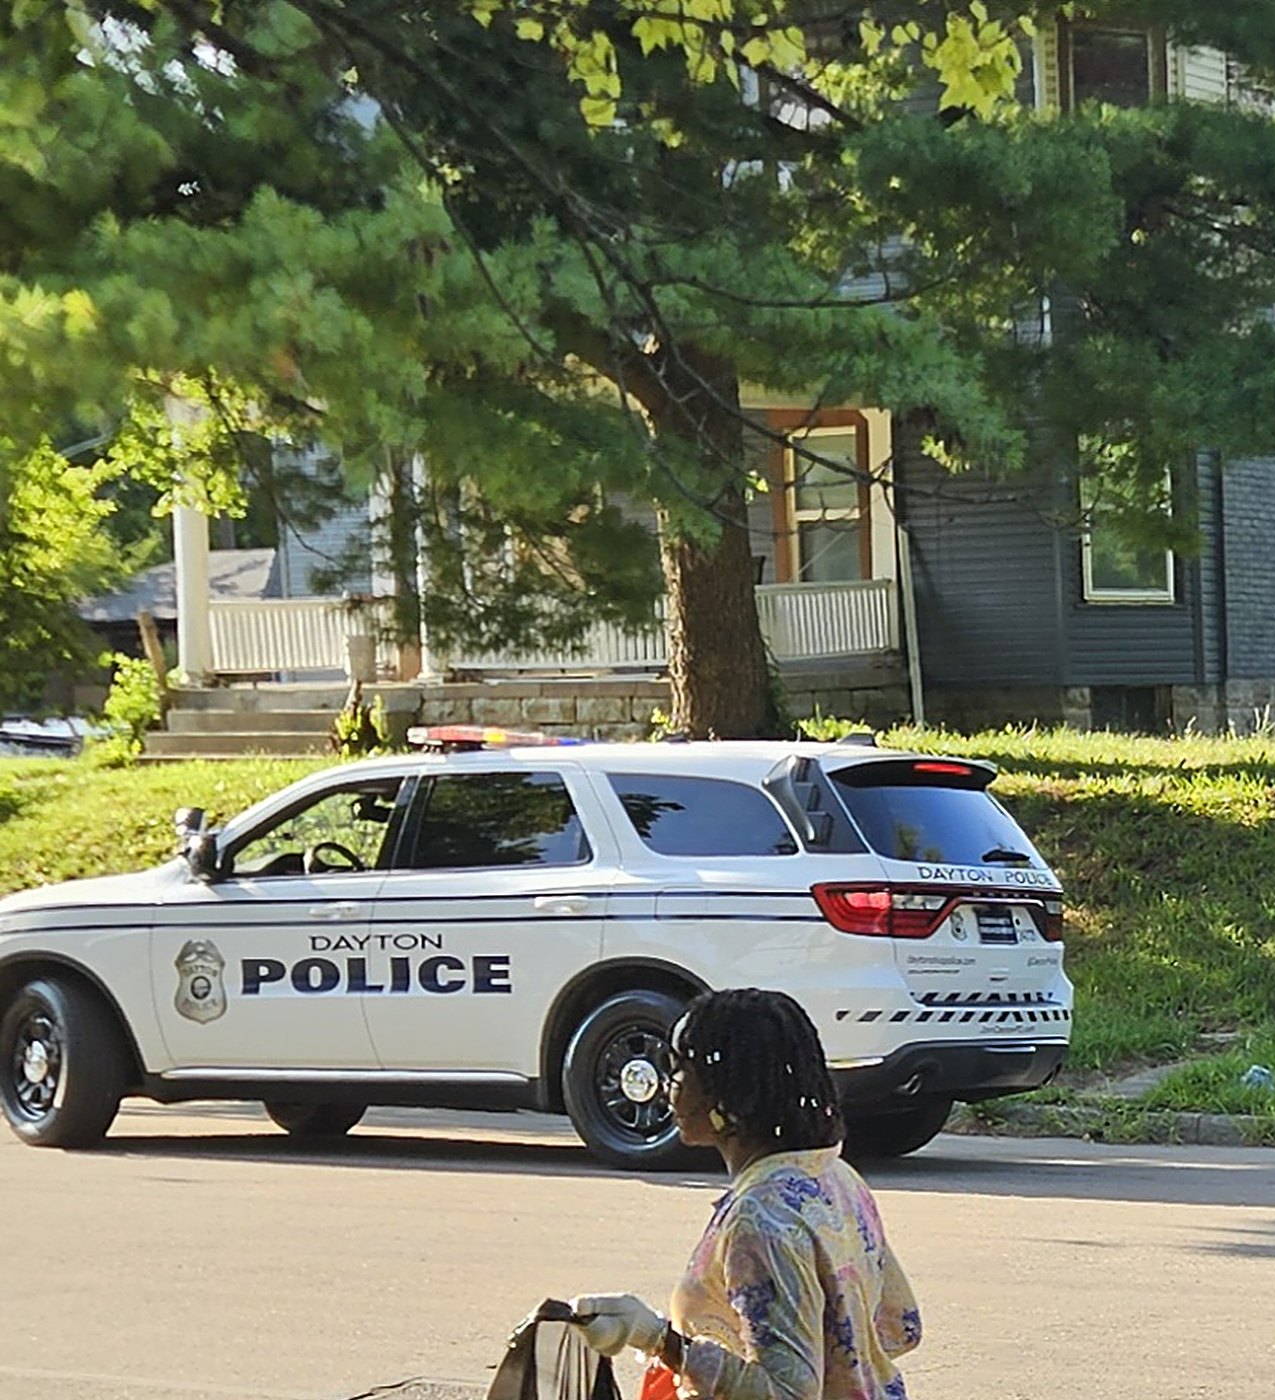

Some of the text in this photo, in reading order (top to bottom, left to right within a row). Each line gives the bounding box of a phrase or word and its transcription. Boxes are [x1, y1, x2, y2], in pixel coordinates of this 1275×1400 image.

[917, 866, 994, 882] DAYTON
[309, 933, 443, 951] DAYTON
[240, 955, 513, 995] POLICE
